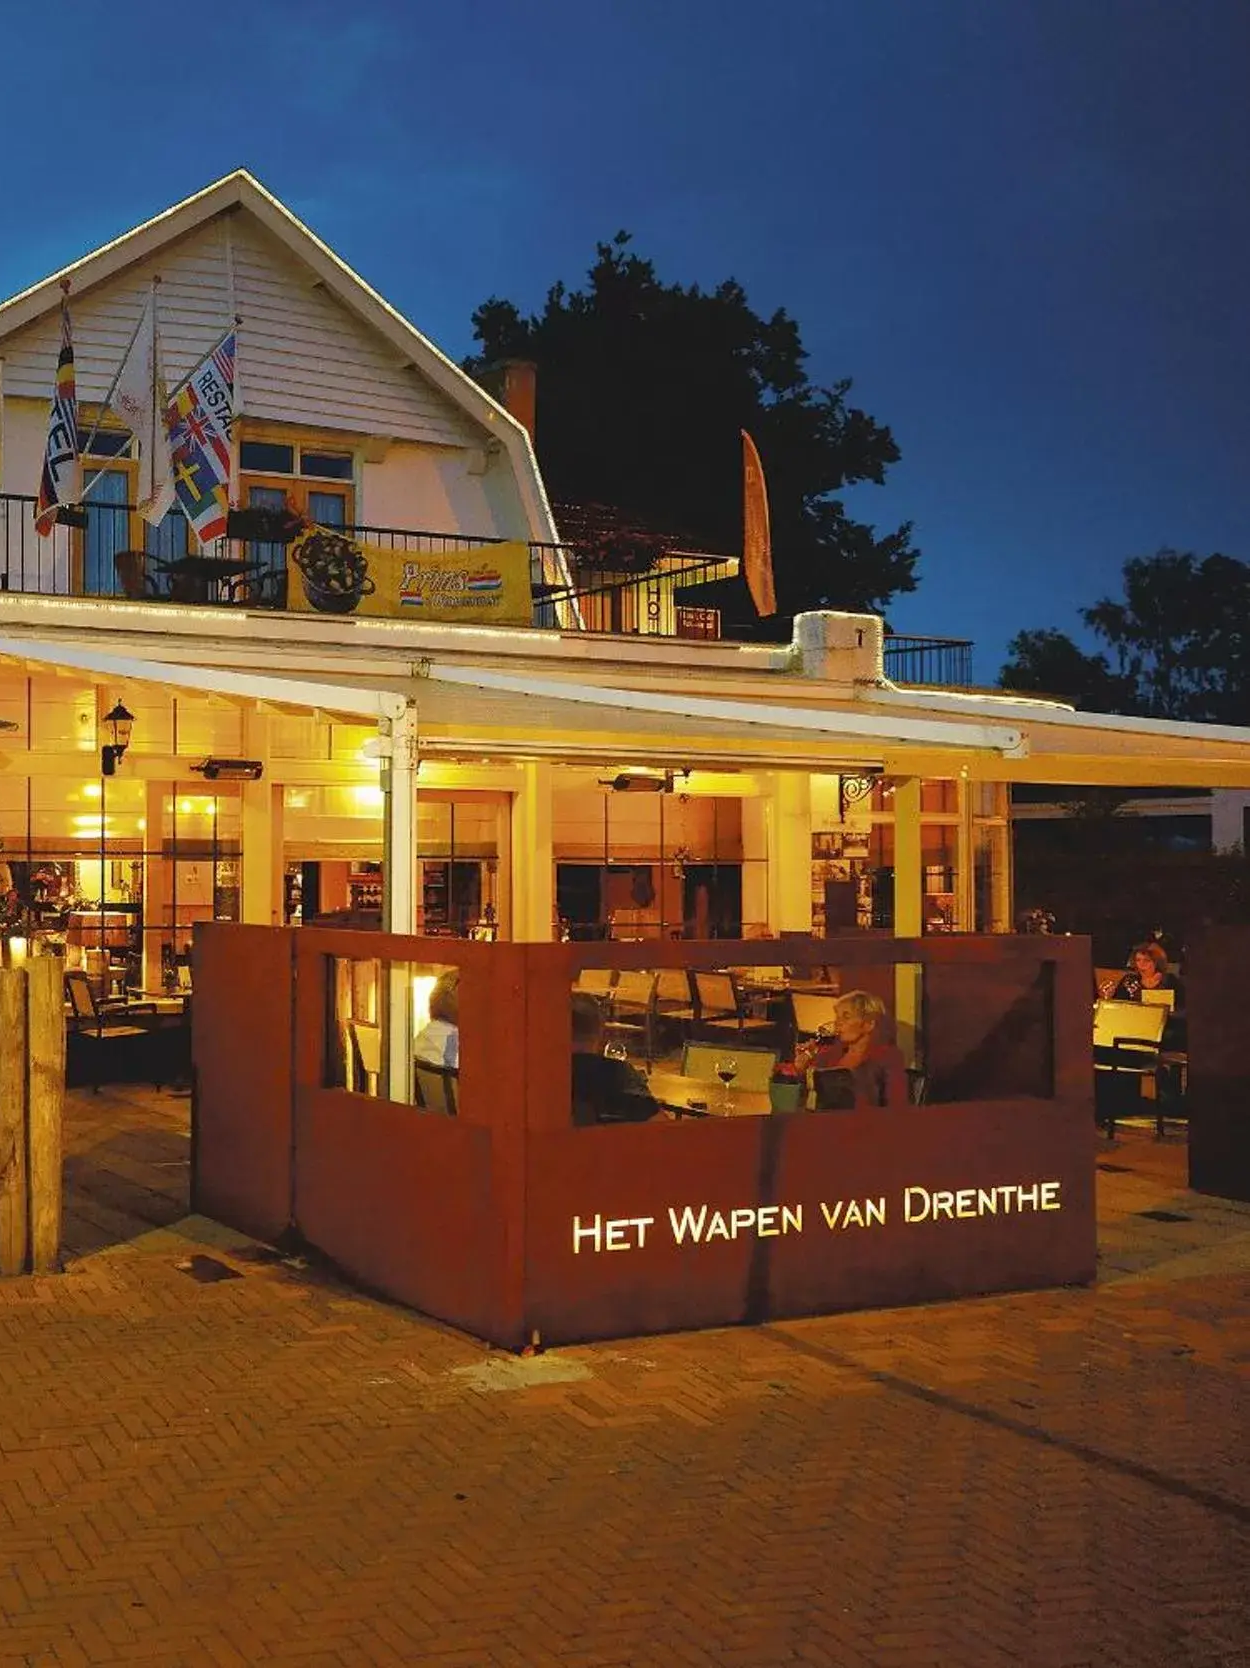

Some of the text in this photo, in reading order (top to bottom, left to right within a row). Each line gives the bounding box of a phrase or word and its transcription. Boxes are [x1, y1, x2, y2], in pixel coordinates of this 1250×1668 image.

[572, 1182, 1061, 1254] HET WAPEN VAN DRENTHE
